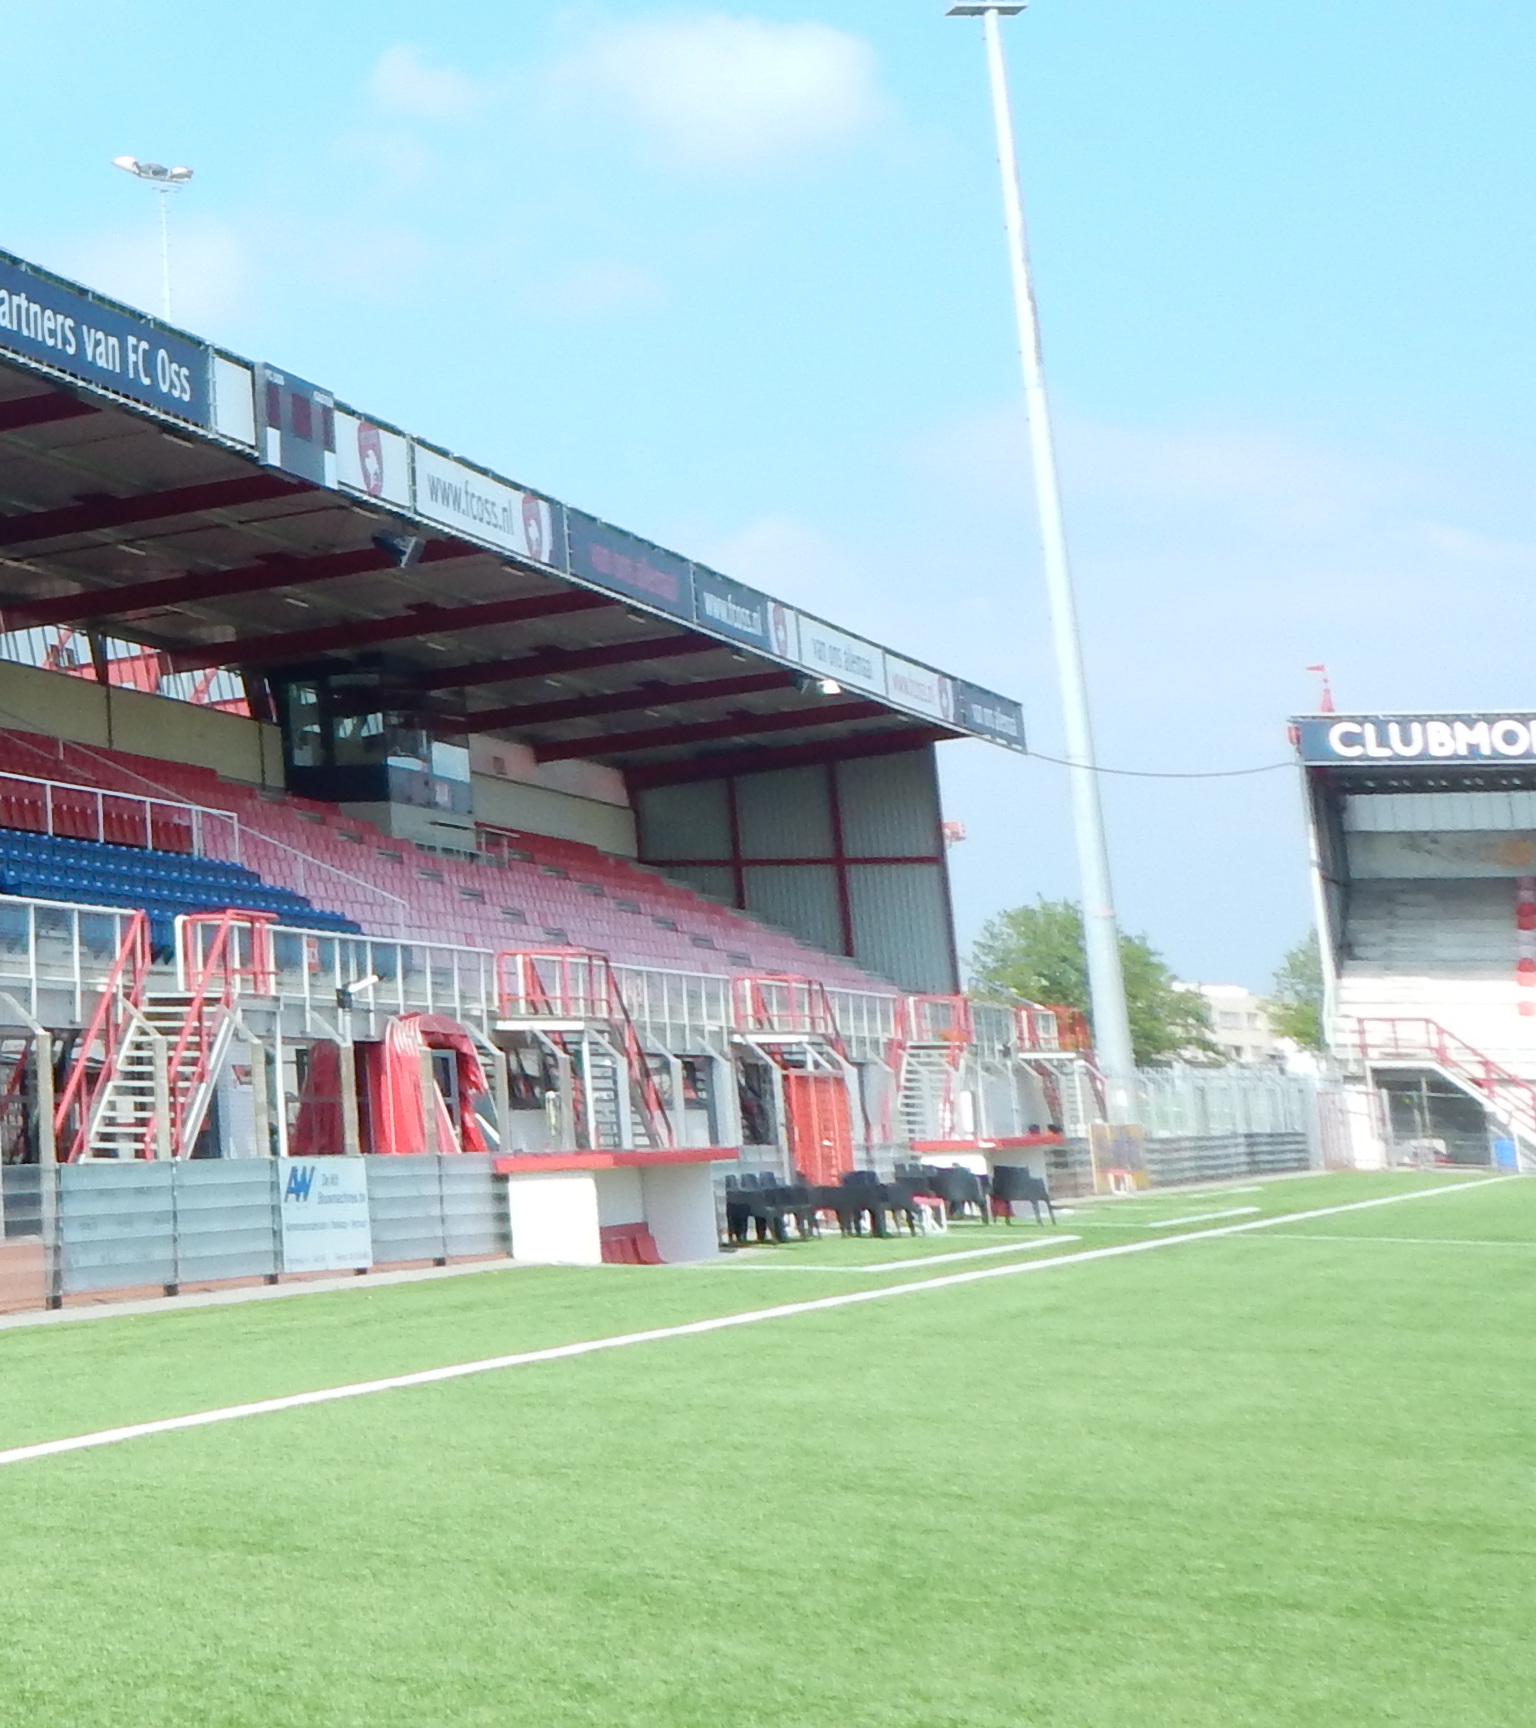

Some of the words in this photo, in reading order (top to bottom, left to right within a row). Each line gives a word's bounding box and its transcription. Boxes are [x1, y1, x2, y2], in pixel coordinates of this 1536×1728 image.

[82, 324, 121, 374] van
[127, 335, 151, 386] FC
[156, 348, 191, 402] Oss
[427, 473, 515, 535] www.fcoss.nl
[1328, 719, 1536, 758] CLUBMO
